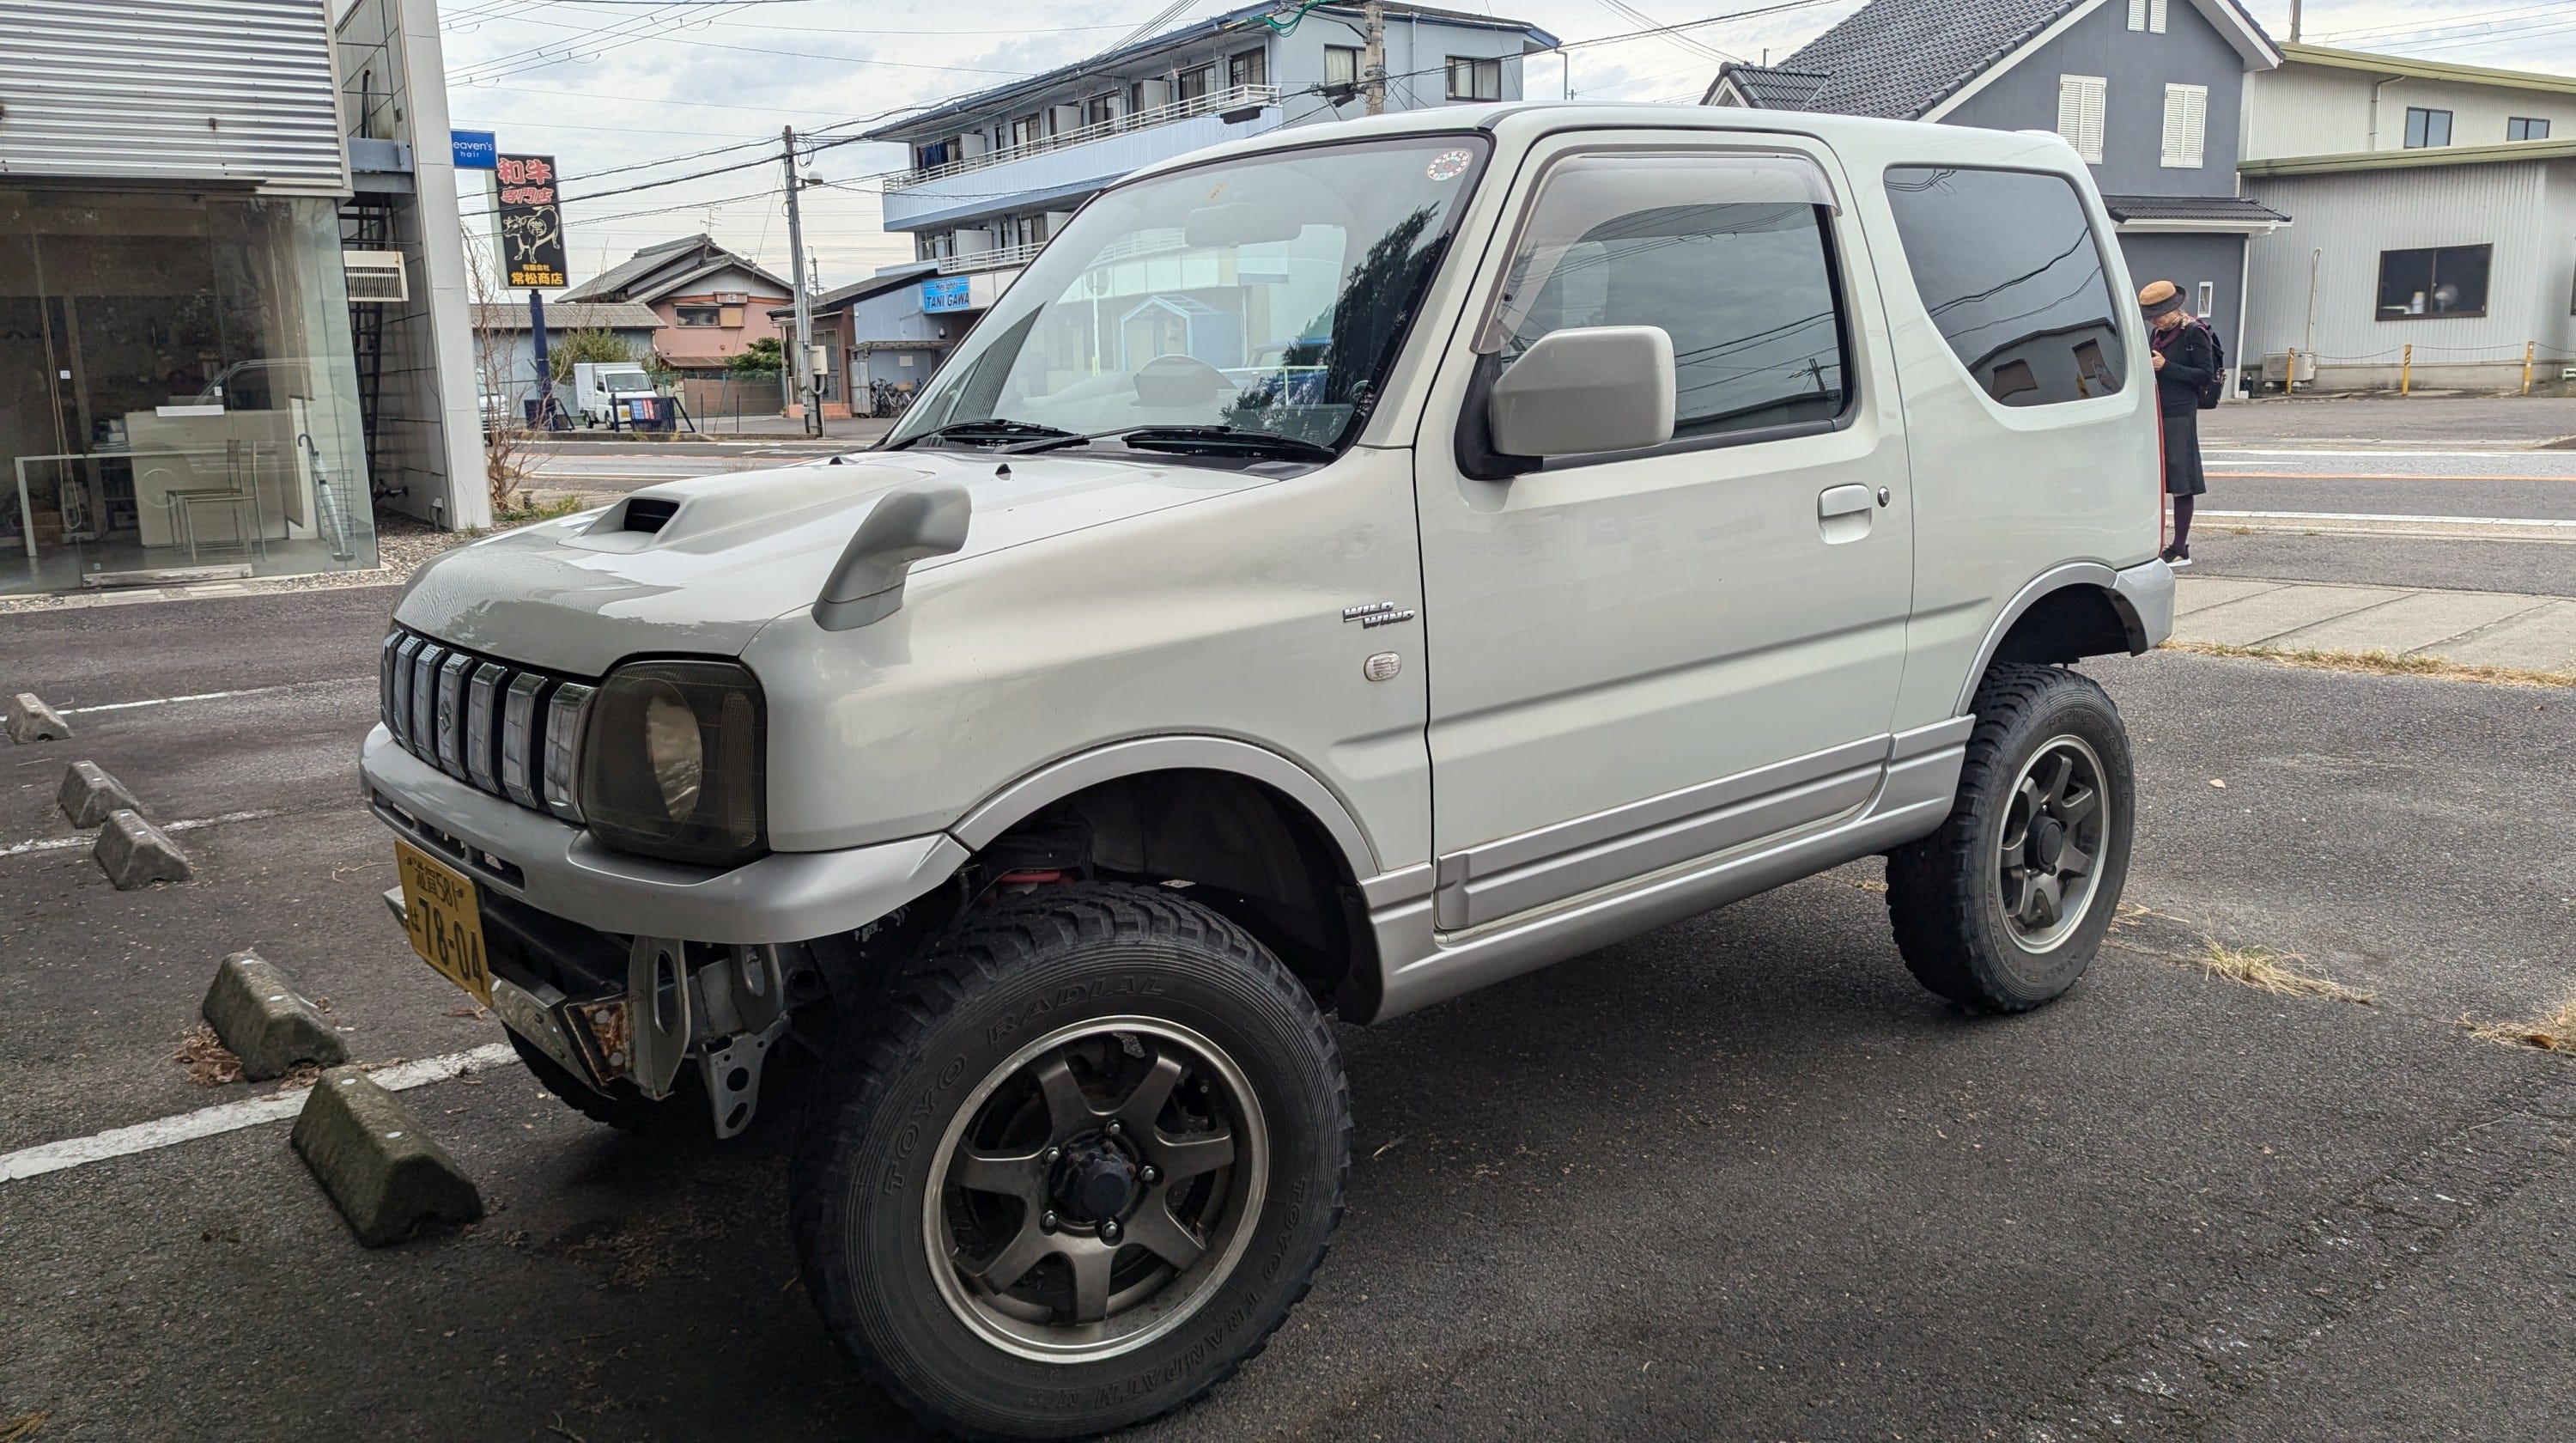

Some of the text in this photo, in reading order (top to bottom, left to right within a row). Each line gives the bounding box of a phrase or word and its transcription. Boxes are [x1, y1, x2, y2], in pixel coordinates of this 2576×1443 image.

[453, 141, 493, 151] eaven's
[498, 158, 552, 185] 和牛
[501, 186, 554, 204] 専門店
[511, 272, 563, 285] 常松商店
[1343, 601, 1394, 622] WILD
[1362, 609, 1416, 630] WIND
[418, 896, 485, 994] 78-04
[884, 974, 1166, 1196] TOYO RADIAL
[1262, 1176, 1307, 1280] TOYO
